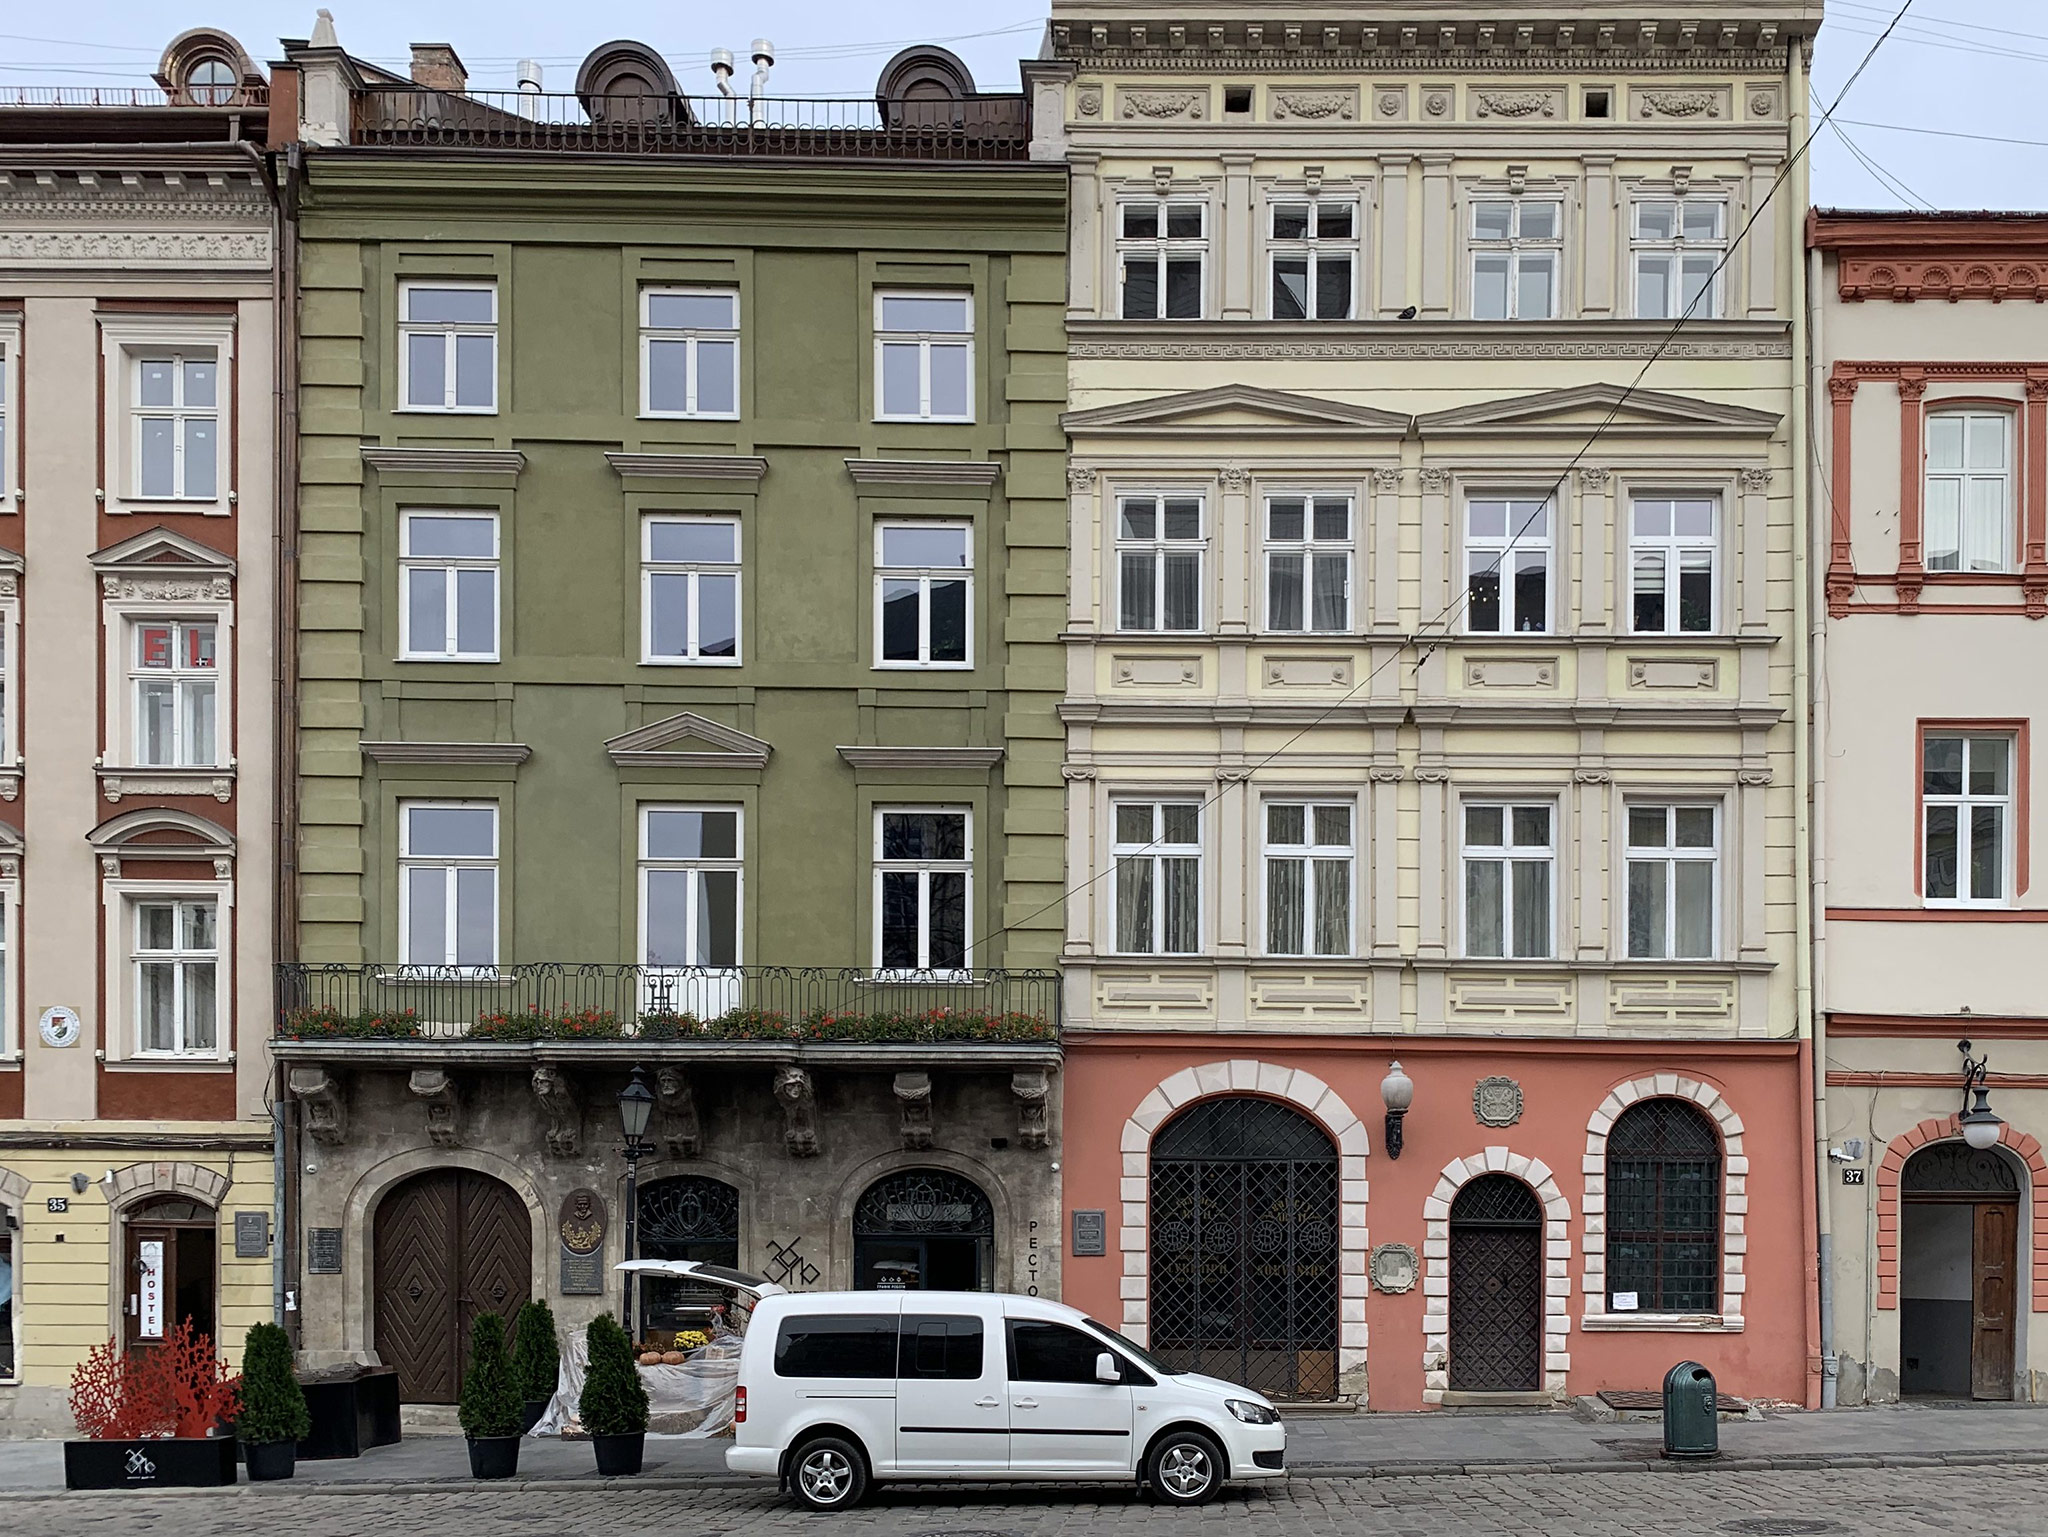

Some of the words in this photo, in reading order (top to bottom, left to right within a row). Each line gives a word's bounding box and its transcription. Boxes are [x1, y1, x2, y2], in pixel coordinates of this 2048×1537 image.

[1845, 1170, 1862, 1183] 37
[49, 1198, 66, 1211] 35
[1257, 1264, 1325, 1276] SOUVNIRS
[147, 1268, 156, 1335] HOSTEL
